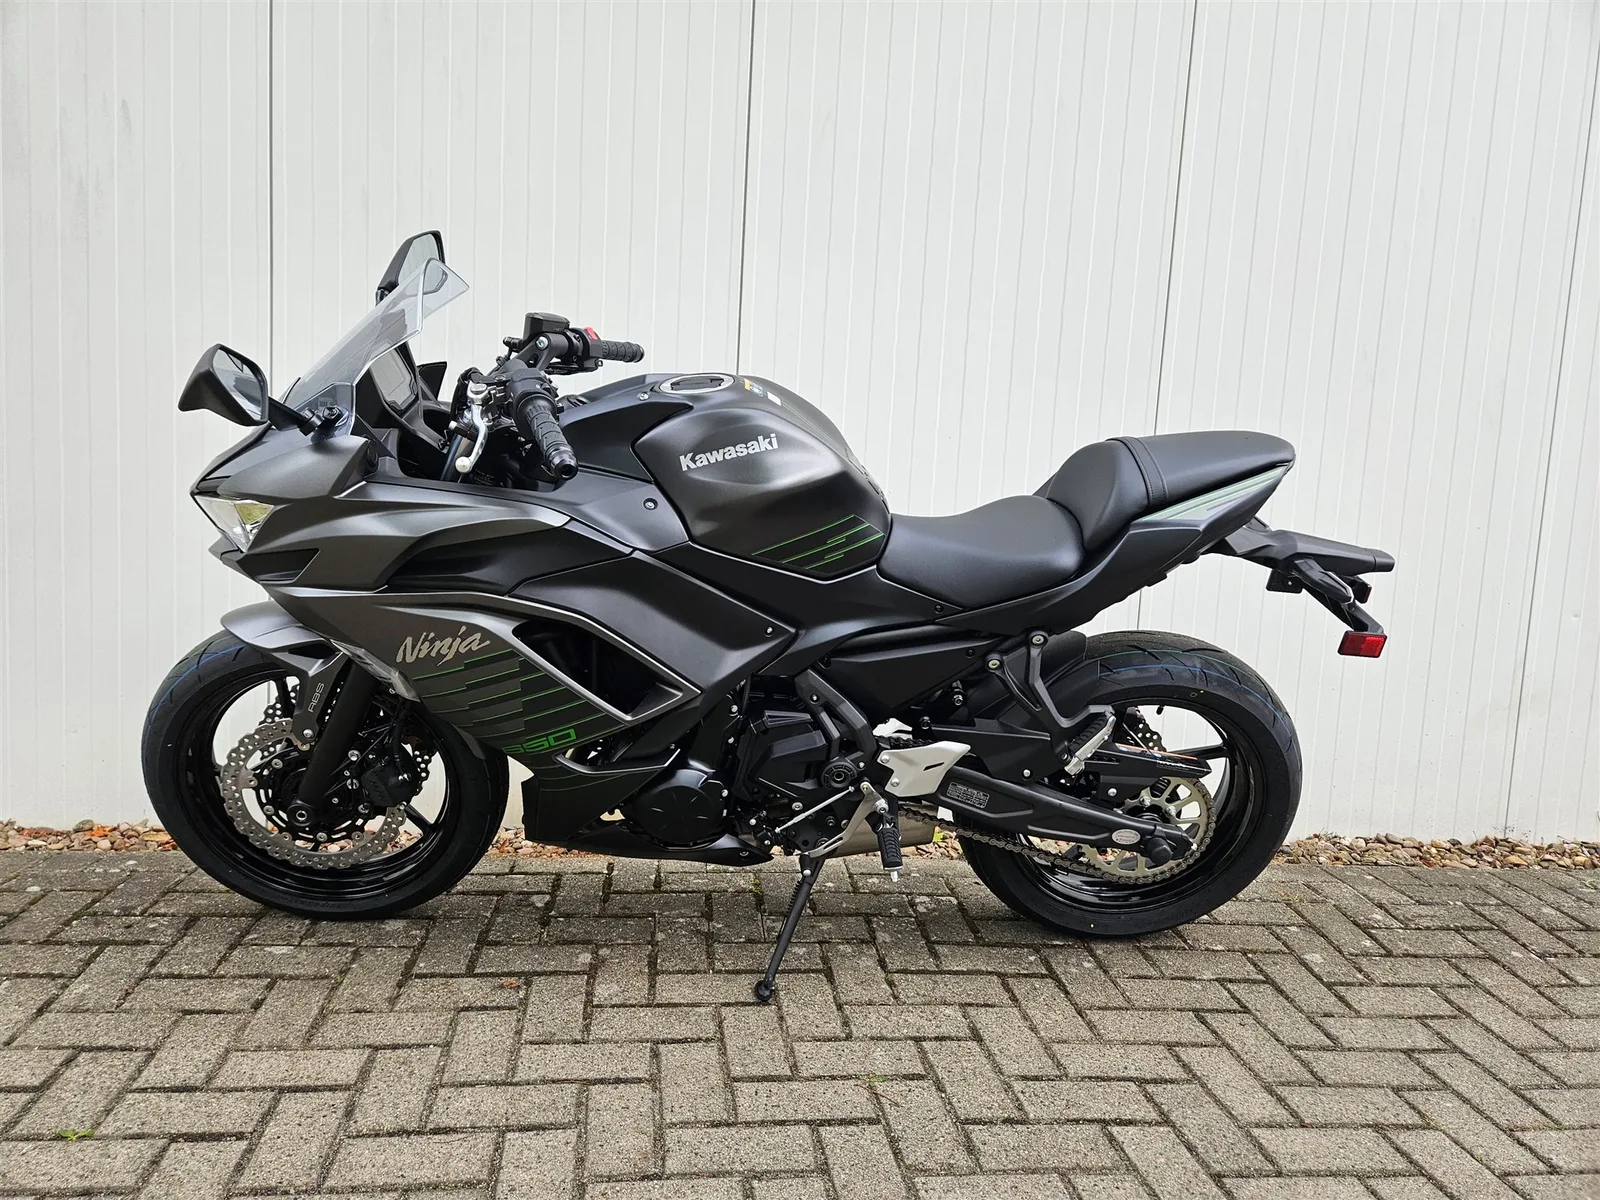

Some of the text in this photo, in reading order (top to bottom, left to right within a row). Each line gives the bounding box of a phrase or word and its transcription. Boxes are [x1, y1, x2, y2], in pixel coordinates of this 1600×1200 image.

[679, 433, 779, 471] Kawasaki
[396, 625, 490, 667] Ninja
[307, 682, 325, 713] ABS
[503, 728, 576, 754] 650
